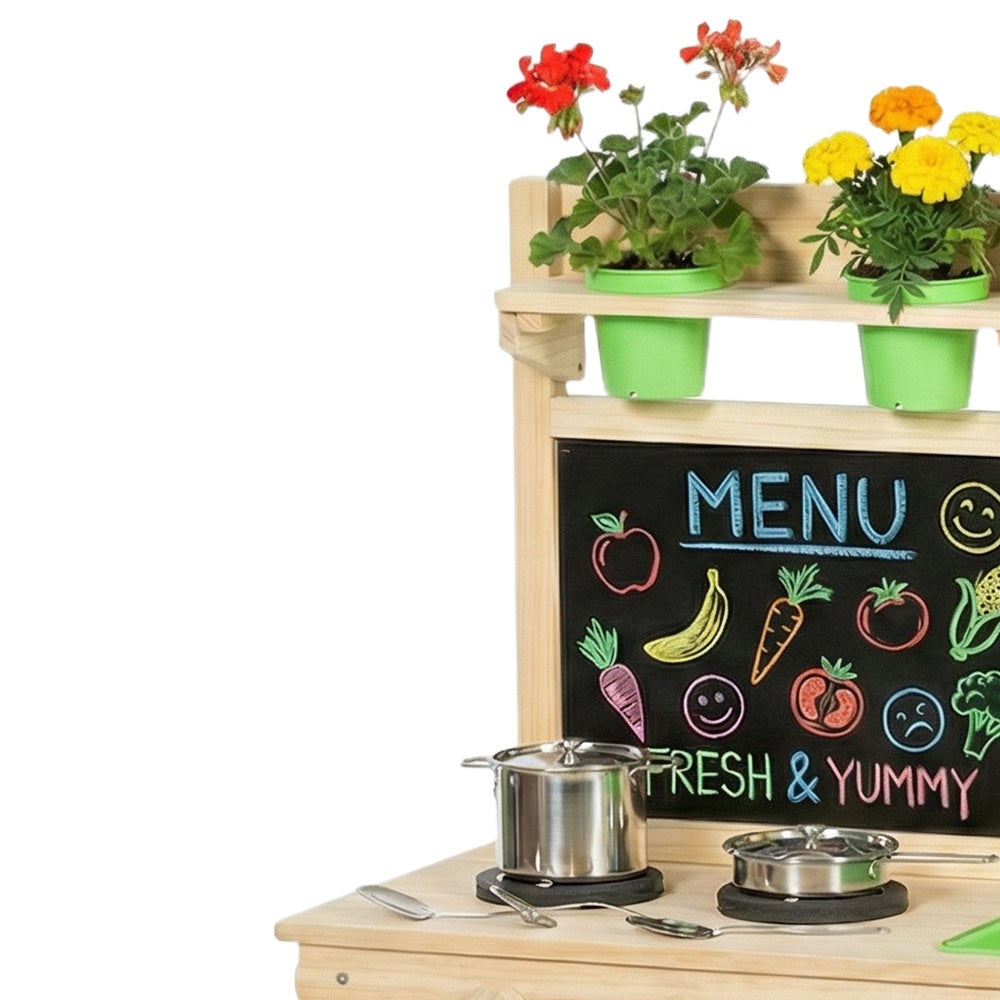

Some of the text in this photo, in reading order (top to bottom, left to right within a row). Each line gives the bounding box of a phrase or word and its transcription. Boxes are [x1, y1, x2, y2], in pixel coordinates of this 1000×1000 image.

[687, 470, 907, 545] MENU
[646, 748, 980, 821] FRESH & YUMMY
